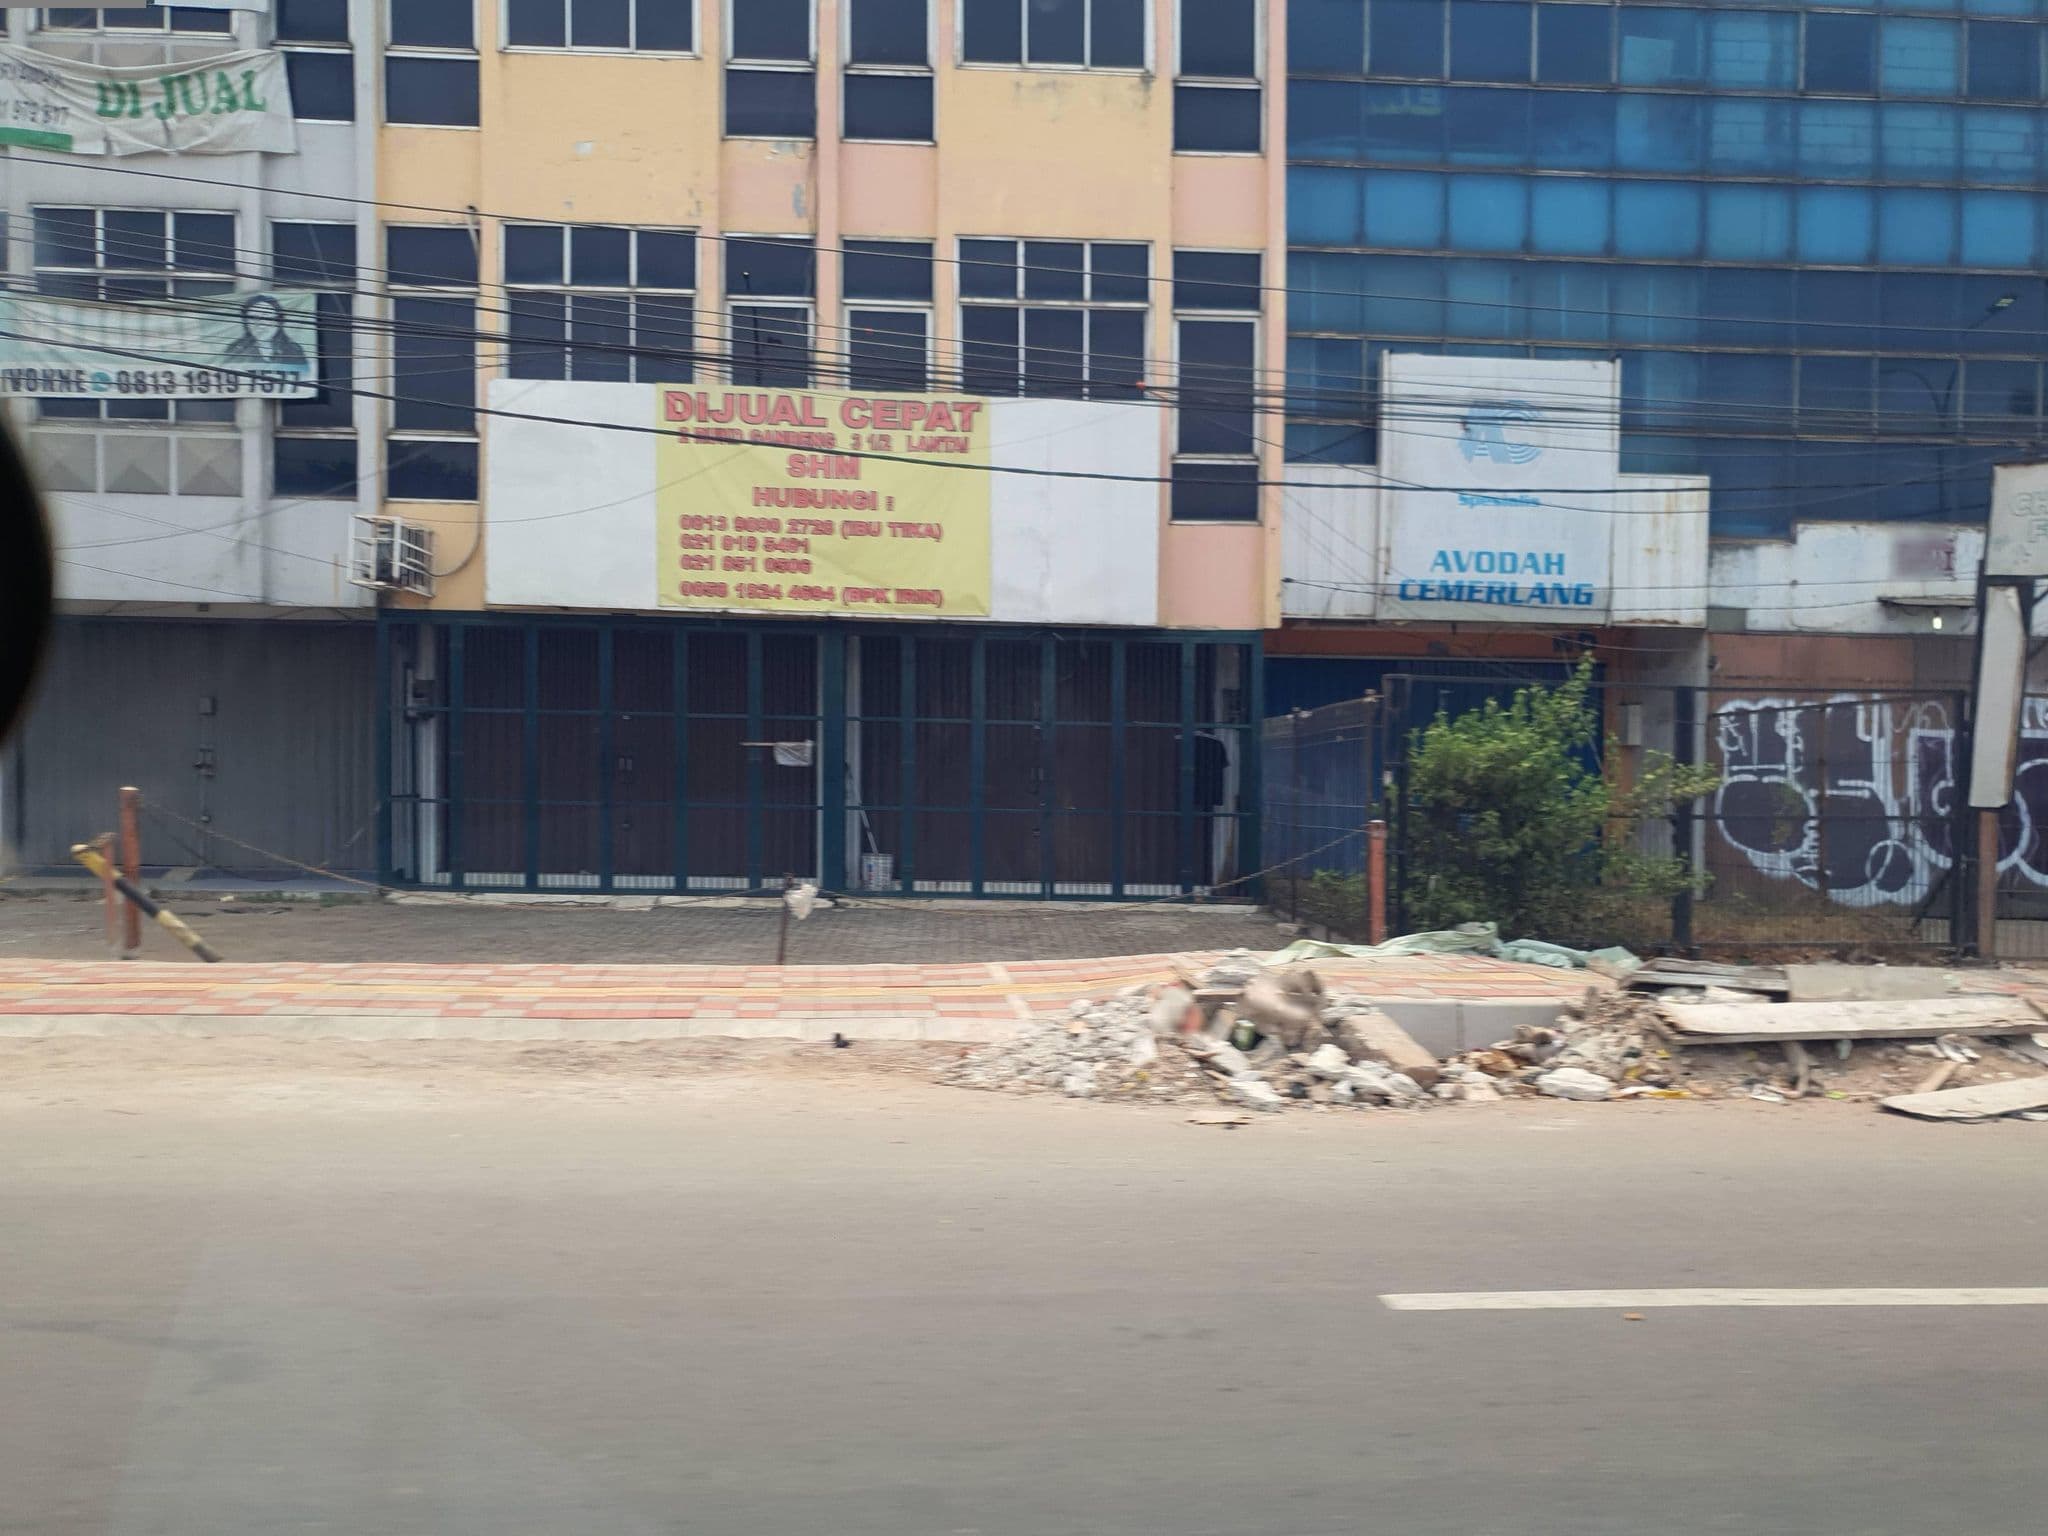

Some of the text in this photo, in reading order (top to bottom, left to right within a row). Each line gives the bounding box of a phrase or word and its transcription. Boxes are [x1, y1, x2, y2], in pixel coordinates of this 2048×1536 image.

[153, 70, 267, 119] JUAL
[116, 370, 177, 394] 0813
[183, 371, 240, 393] 1919
[665, 391, 983, 432] DIJUAL CEPAT
[787, 455, 861, 480] SHM
[752, 486, 879, 511] HUBUNGI
[680, 533, 714, 550] 021
[680, 554, 714, 571] 021
[1431, 550, 1565, 576] AVODAH
[1398, 578, 1594, 606] CEMERLANG
